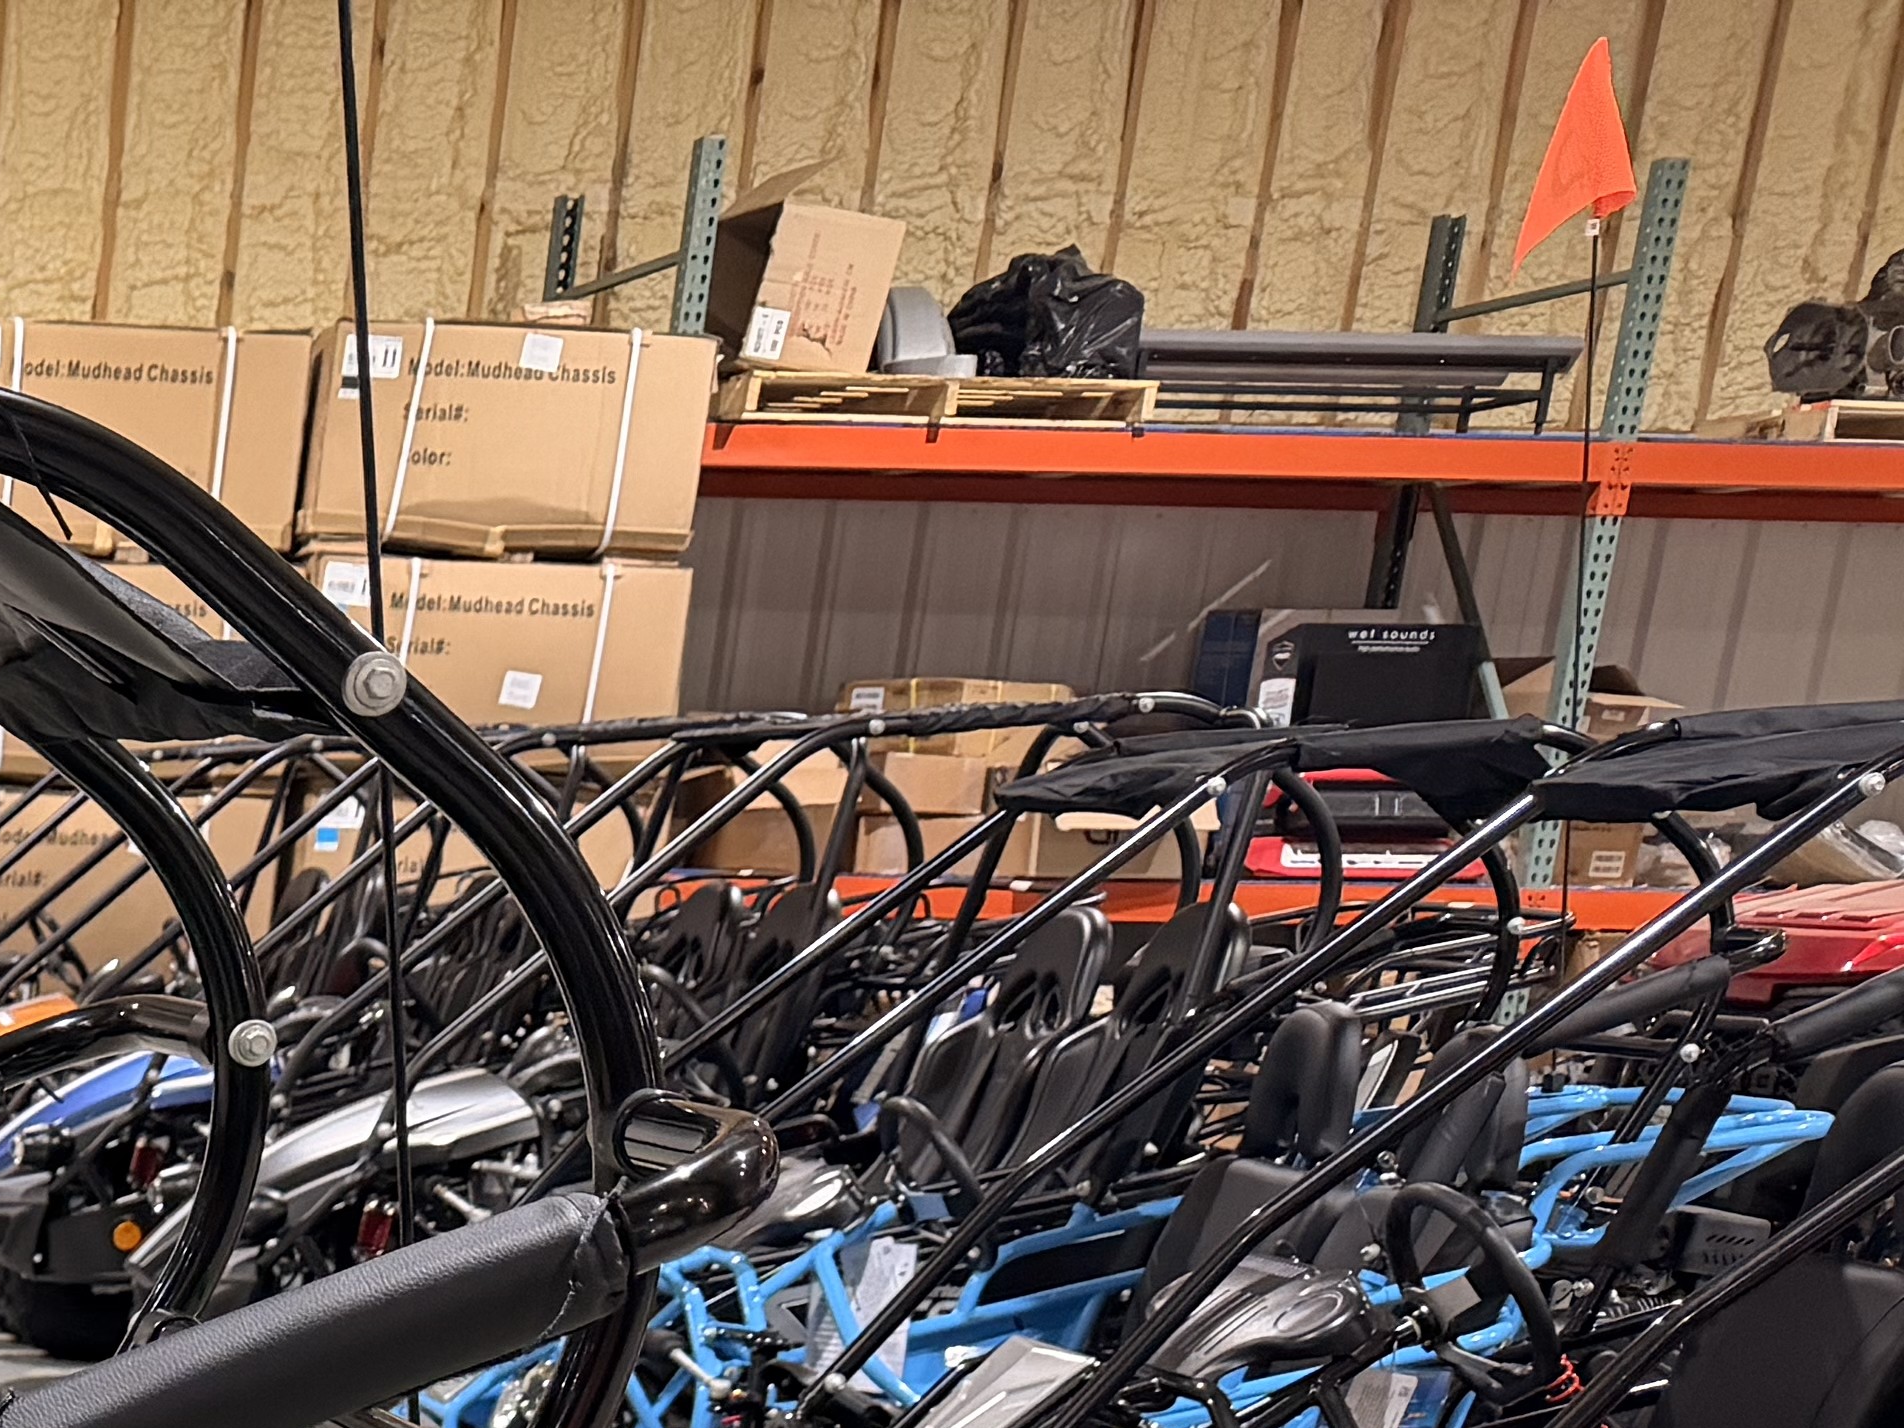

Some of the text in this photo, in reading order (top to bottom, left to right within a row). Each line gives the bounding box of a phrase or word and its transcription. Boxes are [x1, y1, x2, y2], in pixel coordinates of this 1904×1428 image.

[148, 363, 214, 385] Chassis
[409, 448, 451, 466] olor:
[528, 598, 595, 618] Chassis
[387, 636, 451, 655] Srial#:
